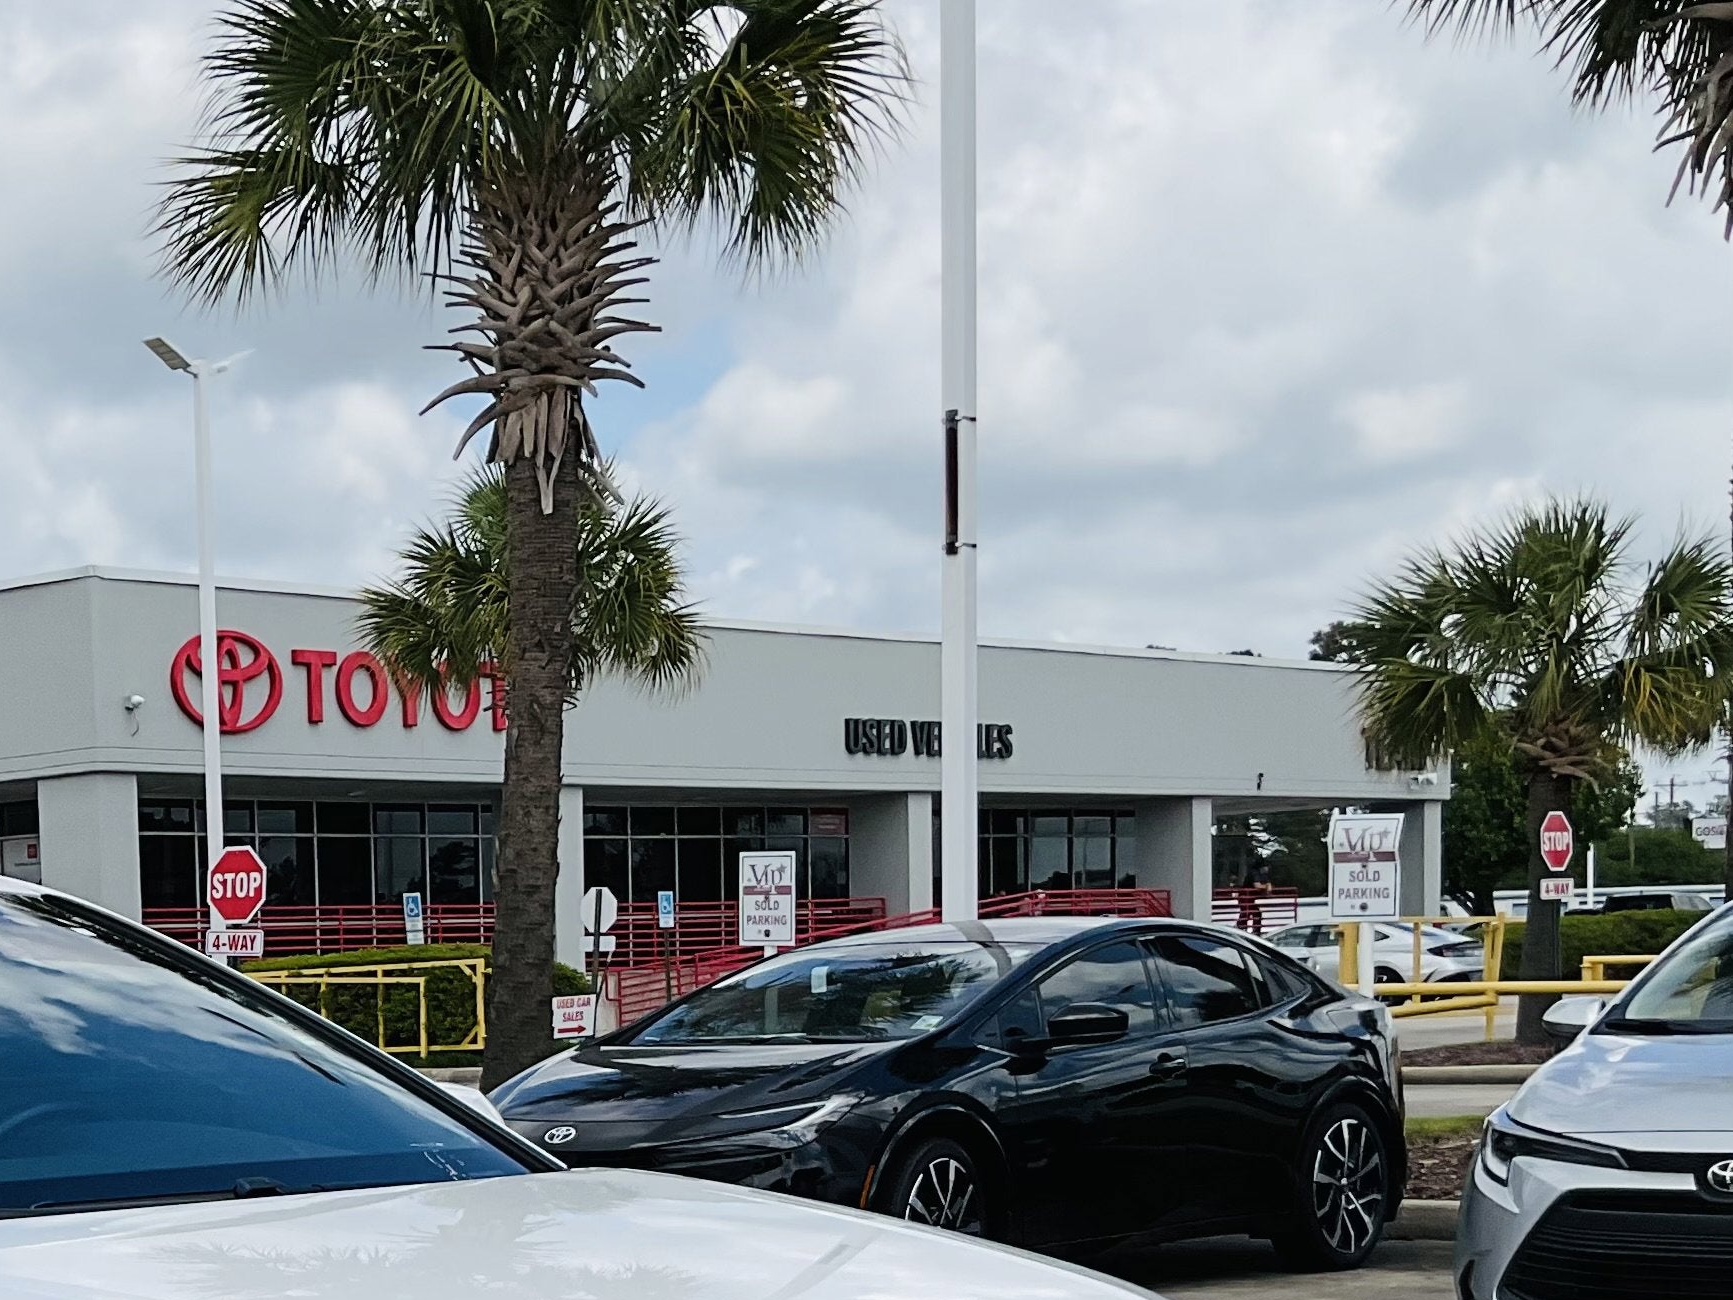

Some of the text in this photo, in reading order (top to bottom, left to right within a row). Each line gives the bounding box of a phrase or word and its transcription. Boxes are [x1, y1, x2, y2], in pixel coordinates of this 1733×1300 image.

[291, 649, 508, 732] TOYOT
[844, 718, 1013, 759] USED VELES
[1543, 831, 1569, 852] STOP
[1348, 870, 1381, 883] SOLD
[211, 871, 261, 899] STOP
[1545, 882, 1570, 896] 4-WAY
[1338, 887, 1390, 900] PARKING
[754, 900, 780, 911] SOLD
[746, 915, 787, 926] PARKING
[212, 934, 257, 952] 4-WAY
[557, 997, 591, 1009] USED CAR
[563, 1011, 584, 1022] SALES
